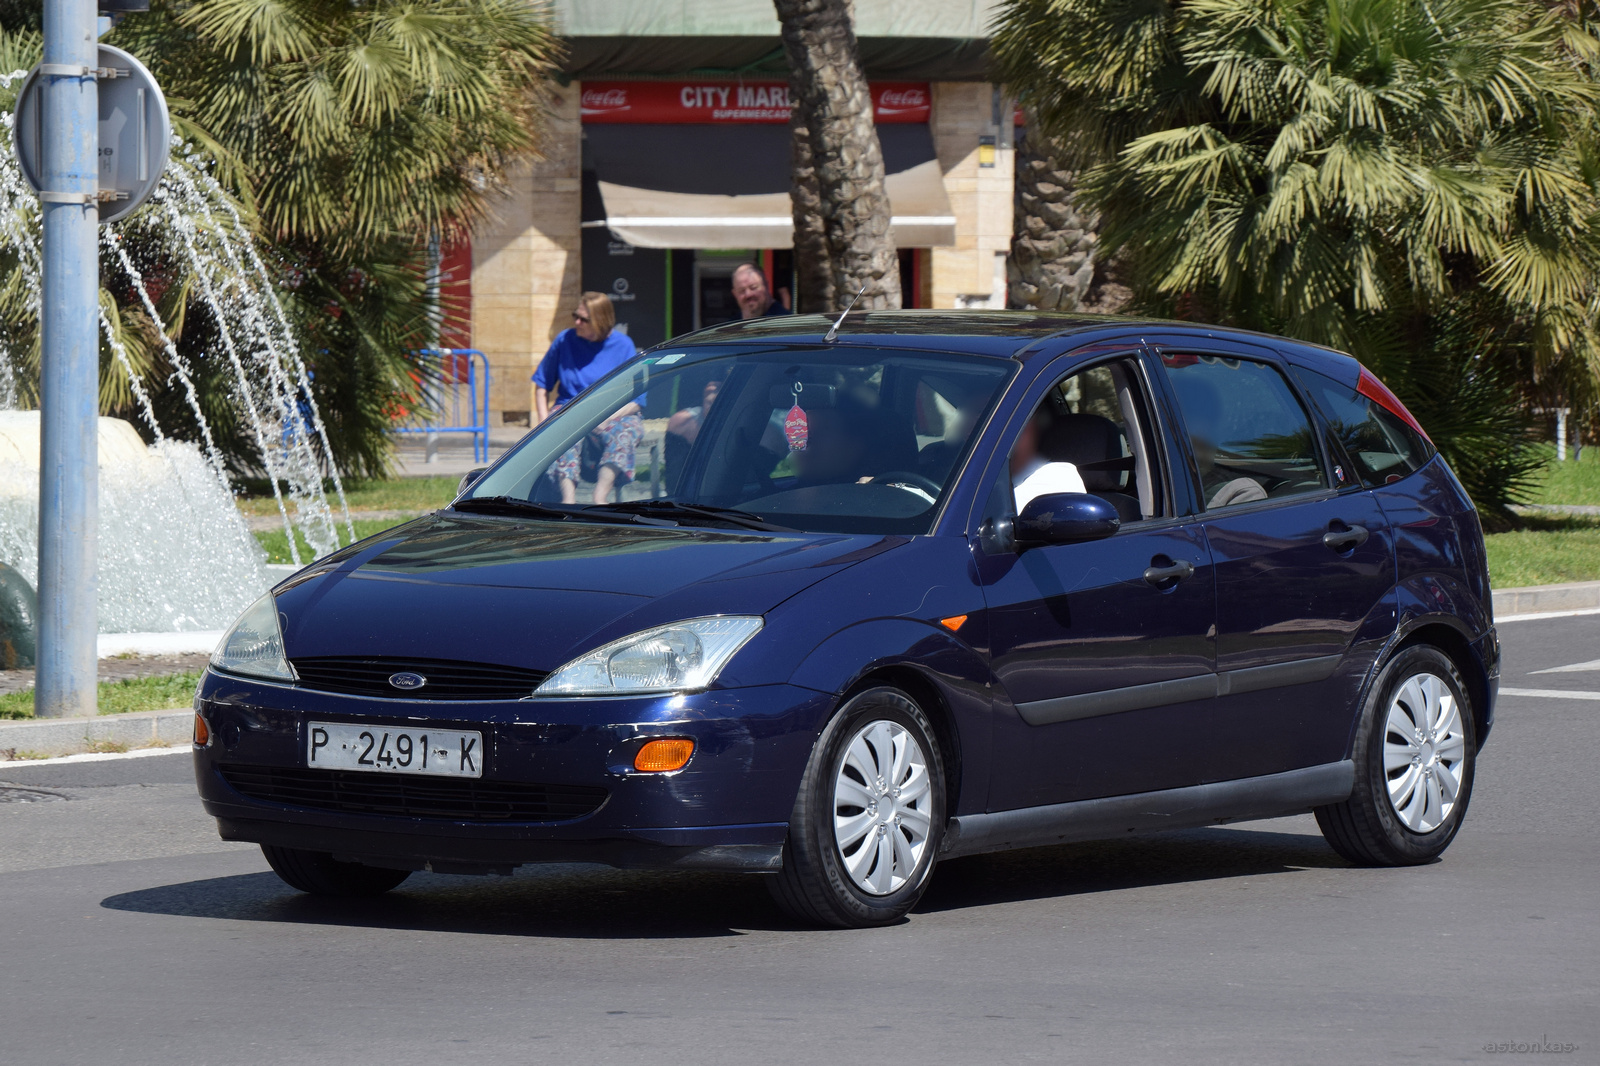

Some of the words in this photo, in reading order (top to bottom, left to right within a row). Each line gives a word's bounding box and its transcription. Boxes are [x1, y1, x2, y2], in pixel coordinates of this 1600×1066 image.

[582, 89, 627, 106] Coca-Cola
[681, 86, 730, 108] CITY
[880, 89, 925, 106] Coca-Cola
[395, 675, 416, 686] Ford
[311, 727, 330, 762] P
[357, 731, 429, 769] 2491
[459, 737, 477, 772] K
